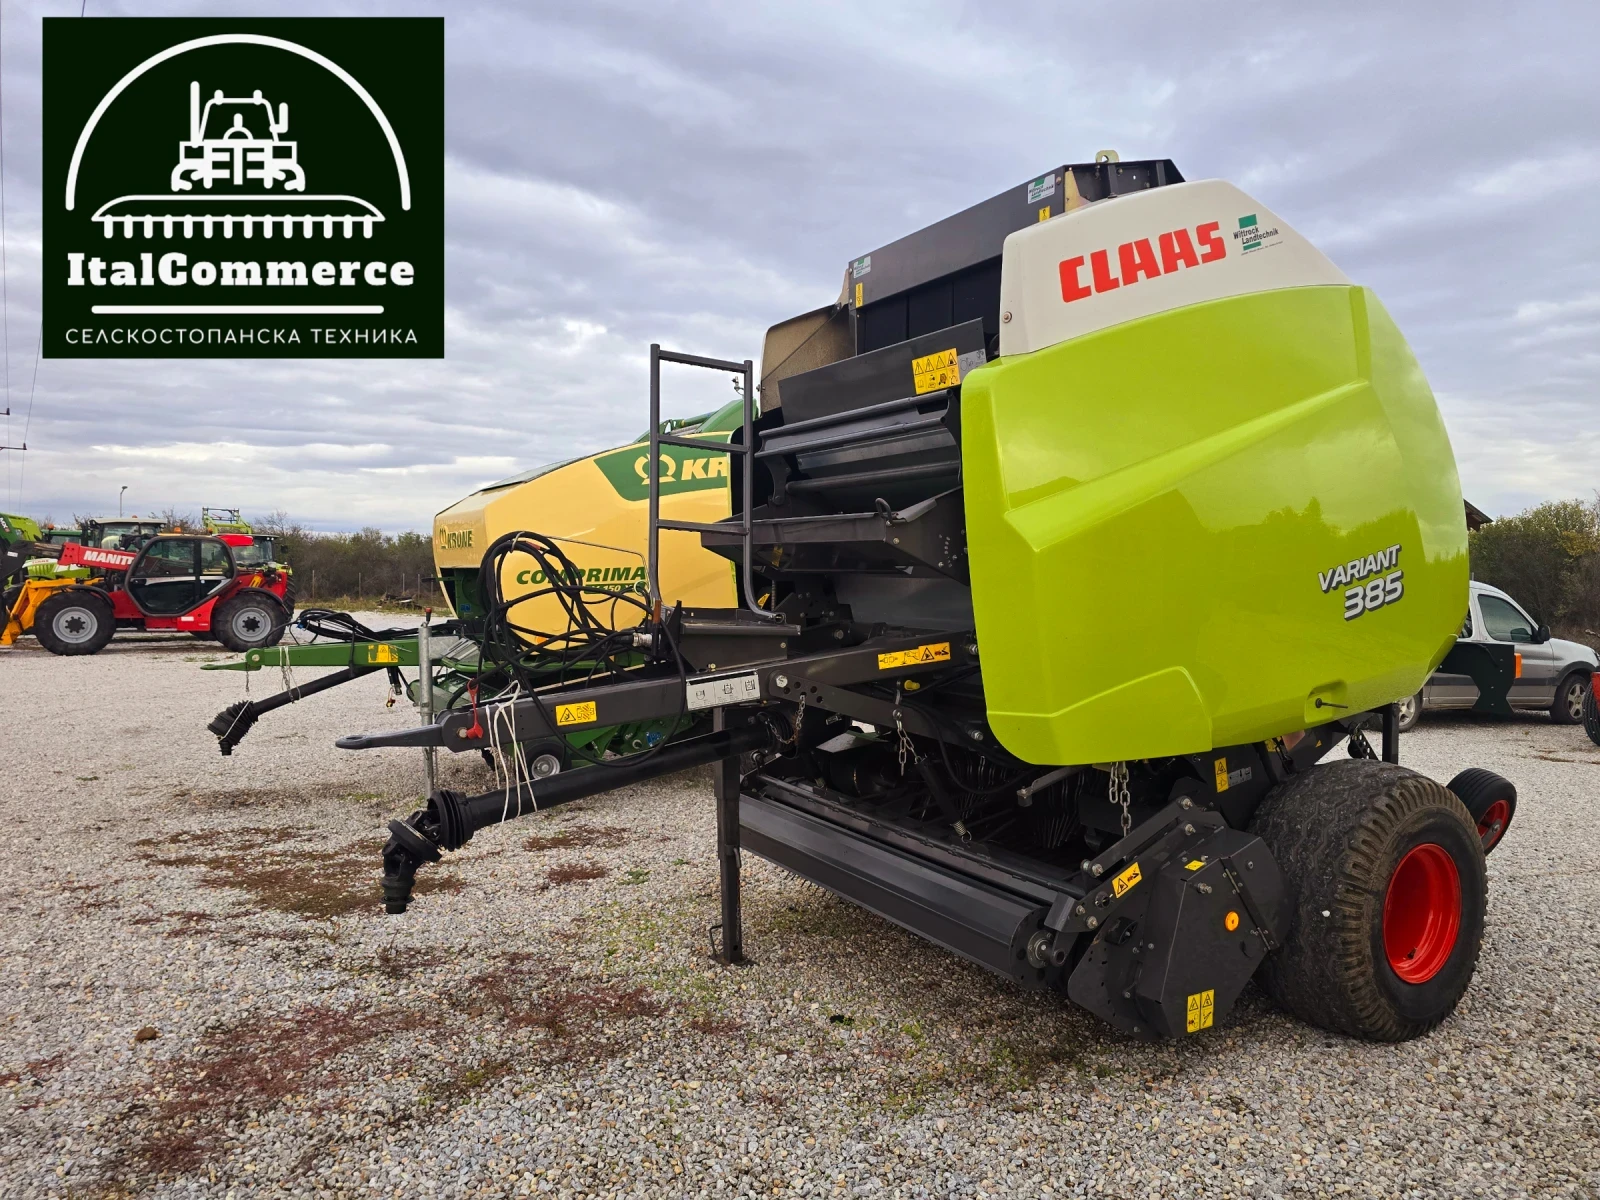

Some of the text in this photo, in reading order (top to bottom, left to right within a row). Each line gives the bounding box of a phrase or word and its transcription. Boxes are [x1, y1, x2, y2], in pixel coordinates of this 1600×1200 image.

[1233, 225, 1259, 240] Wittrock
[1241, 227, 1279, 245] Landtechnik
[1058, 221, 1227, 303] CLAAS
[447, 529, 473, 549] KRONE
[1317, 543, 1402, 593] VARIANT
[1344, 569, 1405, 622] 385
